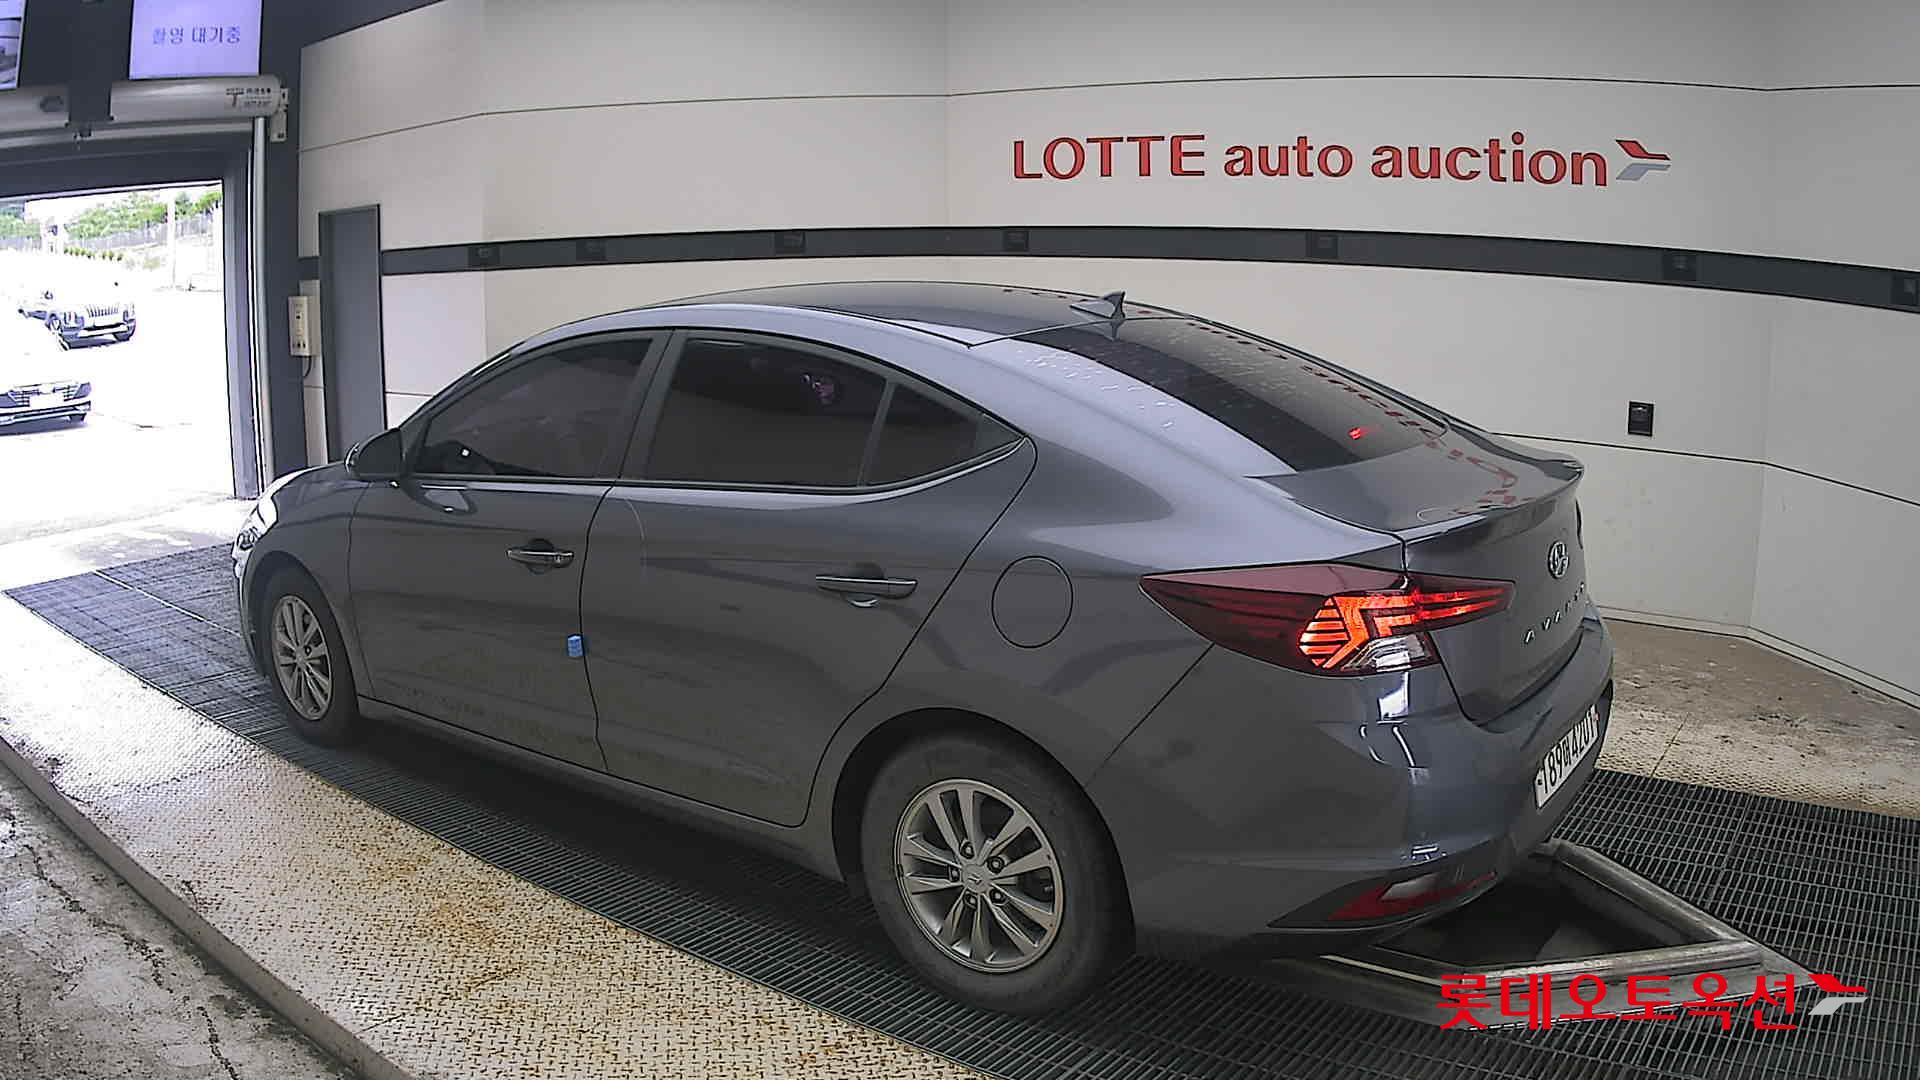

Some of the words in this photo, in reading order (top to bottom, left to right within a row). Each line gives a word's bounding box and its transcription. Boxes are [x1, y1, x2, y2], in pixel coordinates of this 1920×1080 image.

[192, 26, 241, 44] 대기중
[1013, 134, 1204, 181] LOTTE
[1224, 137, 1356, 177] auto
[1370, 132, 1608, 188] auction
